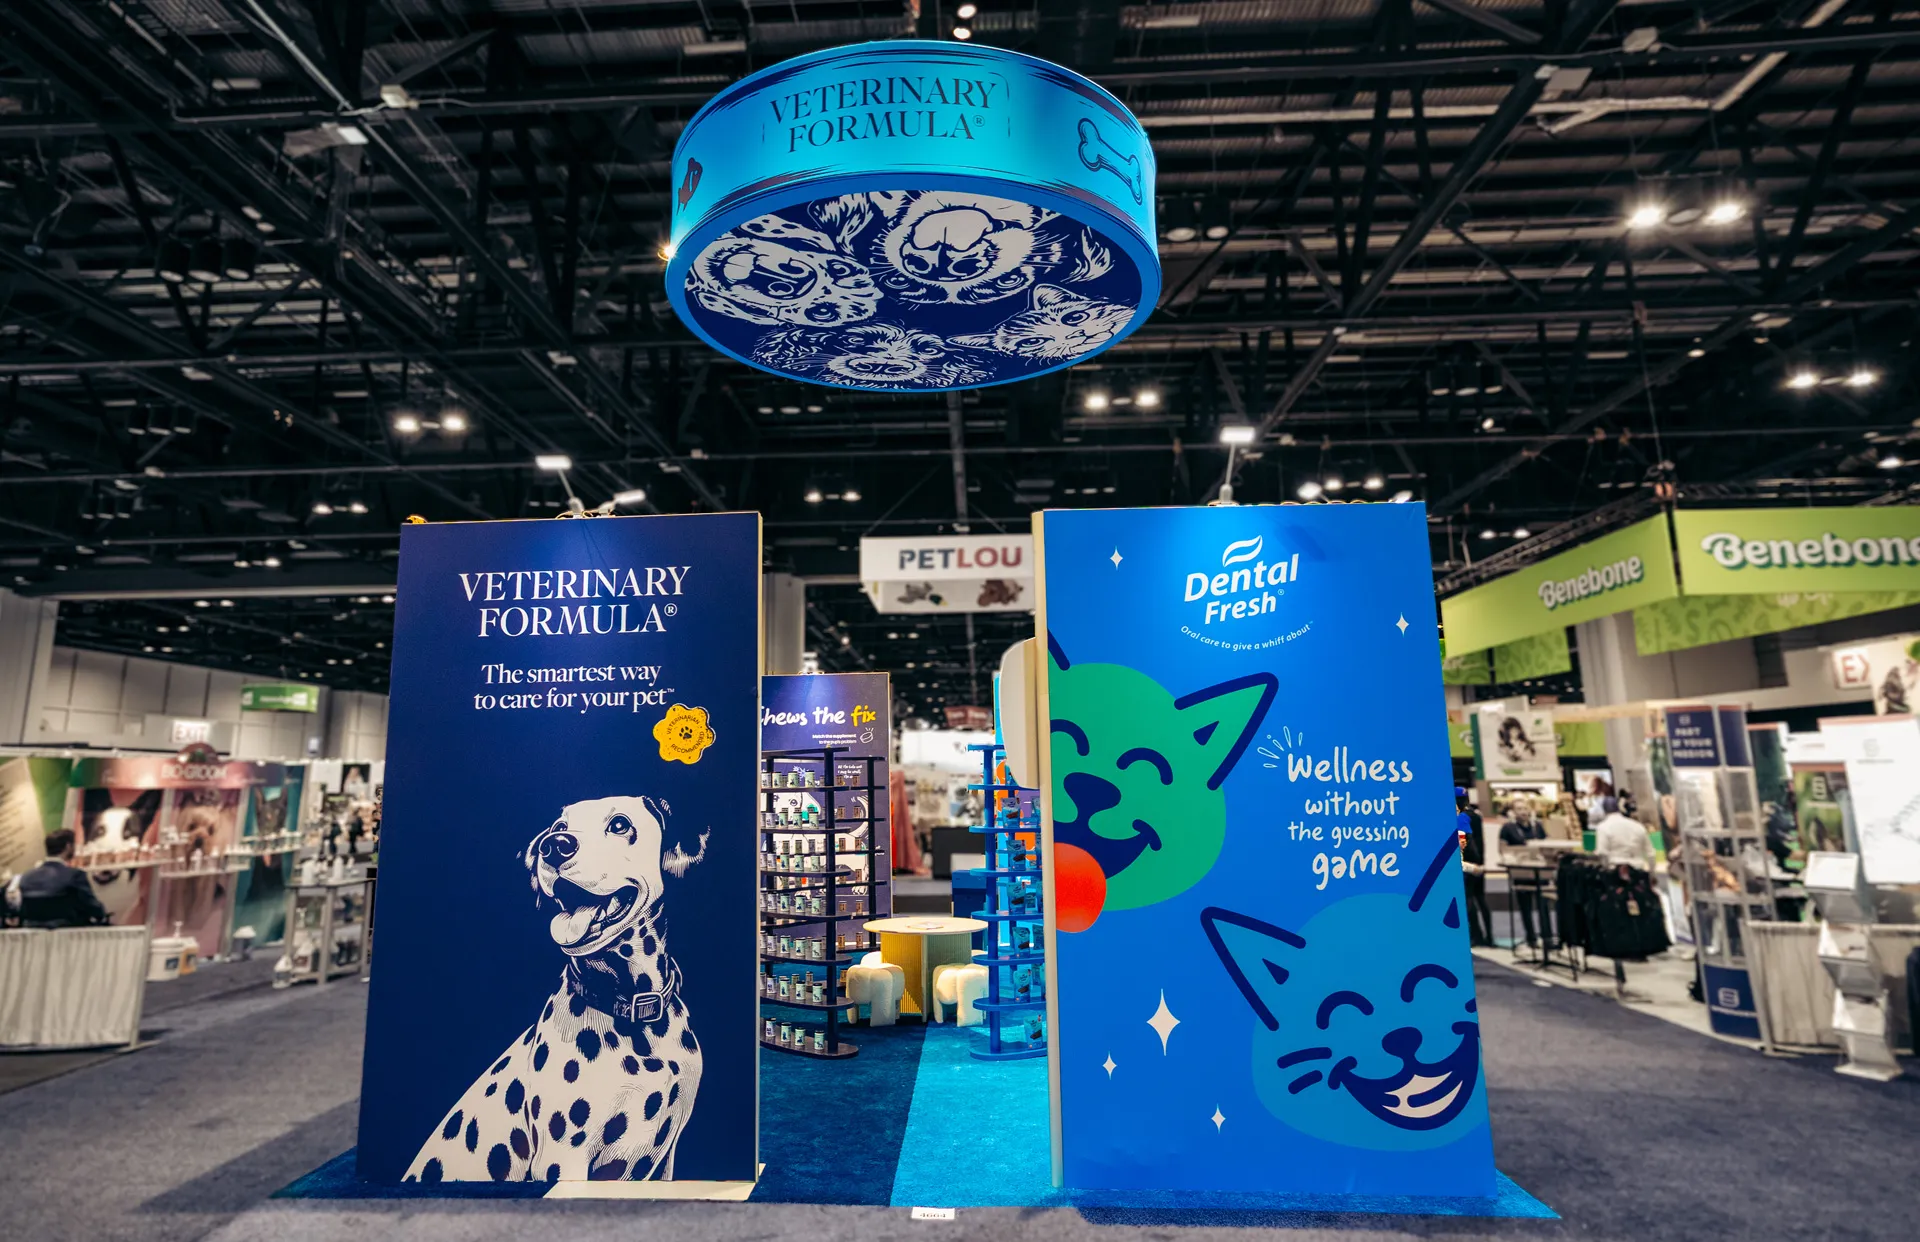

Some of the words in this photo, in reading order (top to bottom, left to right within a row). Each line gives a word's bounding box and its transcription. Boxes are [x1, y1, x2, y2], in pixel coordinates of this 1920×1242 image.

[769, 75, 998, 125] VETERINARY
[898, 546, 1023, 570] PETLOU
[458, 565, 692, 602] VETERINARY
[1183, 552, 1300, 603] Dental
[1537, 555, 1645, 610] Benebone
[1180, 625, 1200, 640] Oral
[1200, 635, 1220, 648] care
[1221, 641, 1231, 649] to
[1232, 642, 1252, 652] give
[1261, 634, 1285, 649] whiff
[481, 663, 524, 684] The
[526, 665, 615, 684] smartest
[619, 665, 662, 687] way
[473, 692, 496, 710] to
[499, 692, 543, 709] care
[546, 687, 577, 709] for
[580, 692, 630, 714] your
[667, 714, 701, 735] VETERINARIAN
[760, 706, 808, 727] hews
[812, 706, 846, 724] the
[850, 705, 876, 727] fix
[1287, 746, 1413, 783] Wellness
[1304, 791, 1400, 816] without
[1287, 821, 1324, 841] the
[1331, 820, 1410, 848] guessing
[1312, 849, 1400, 890] game
